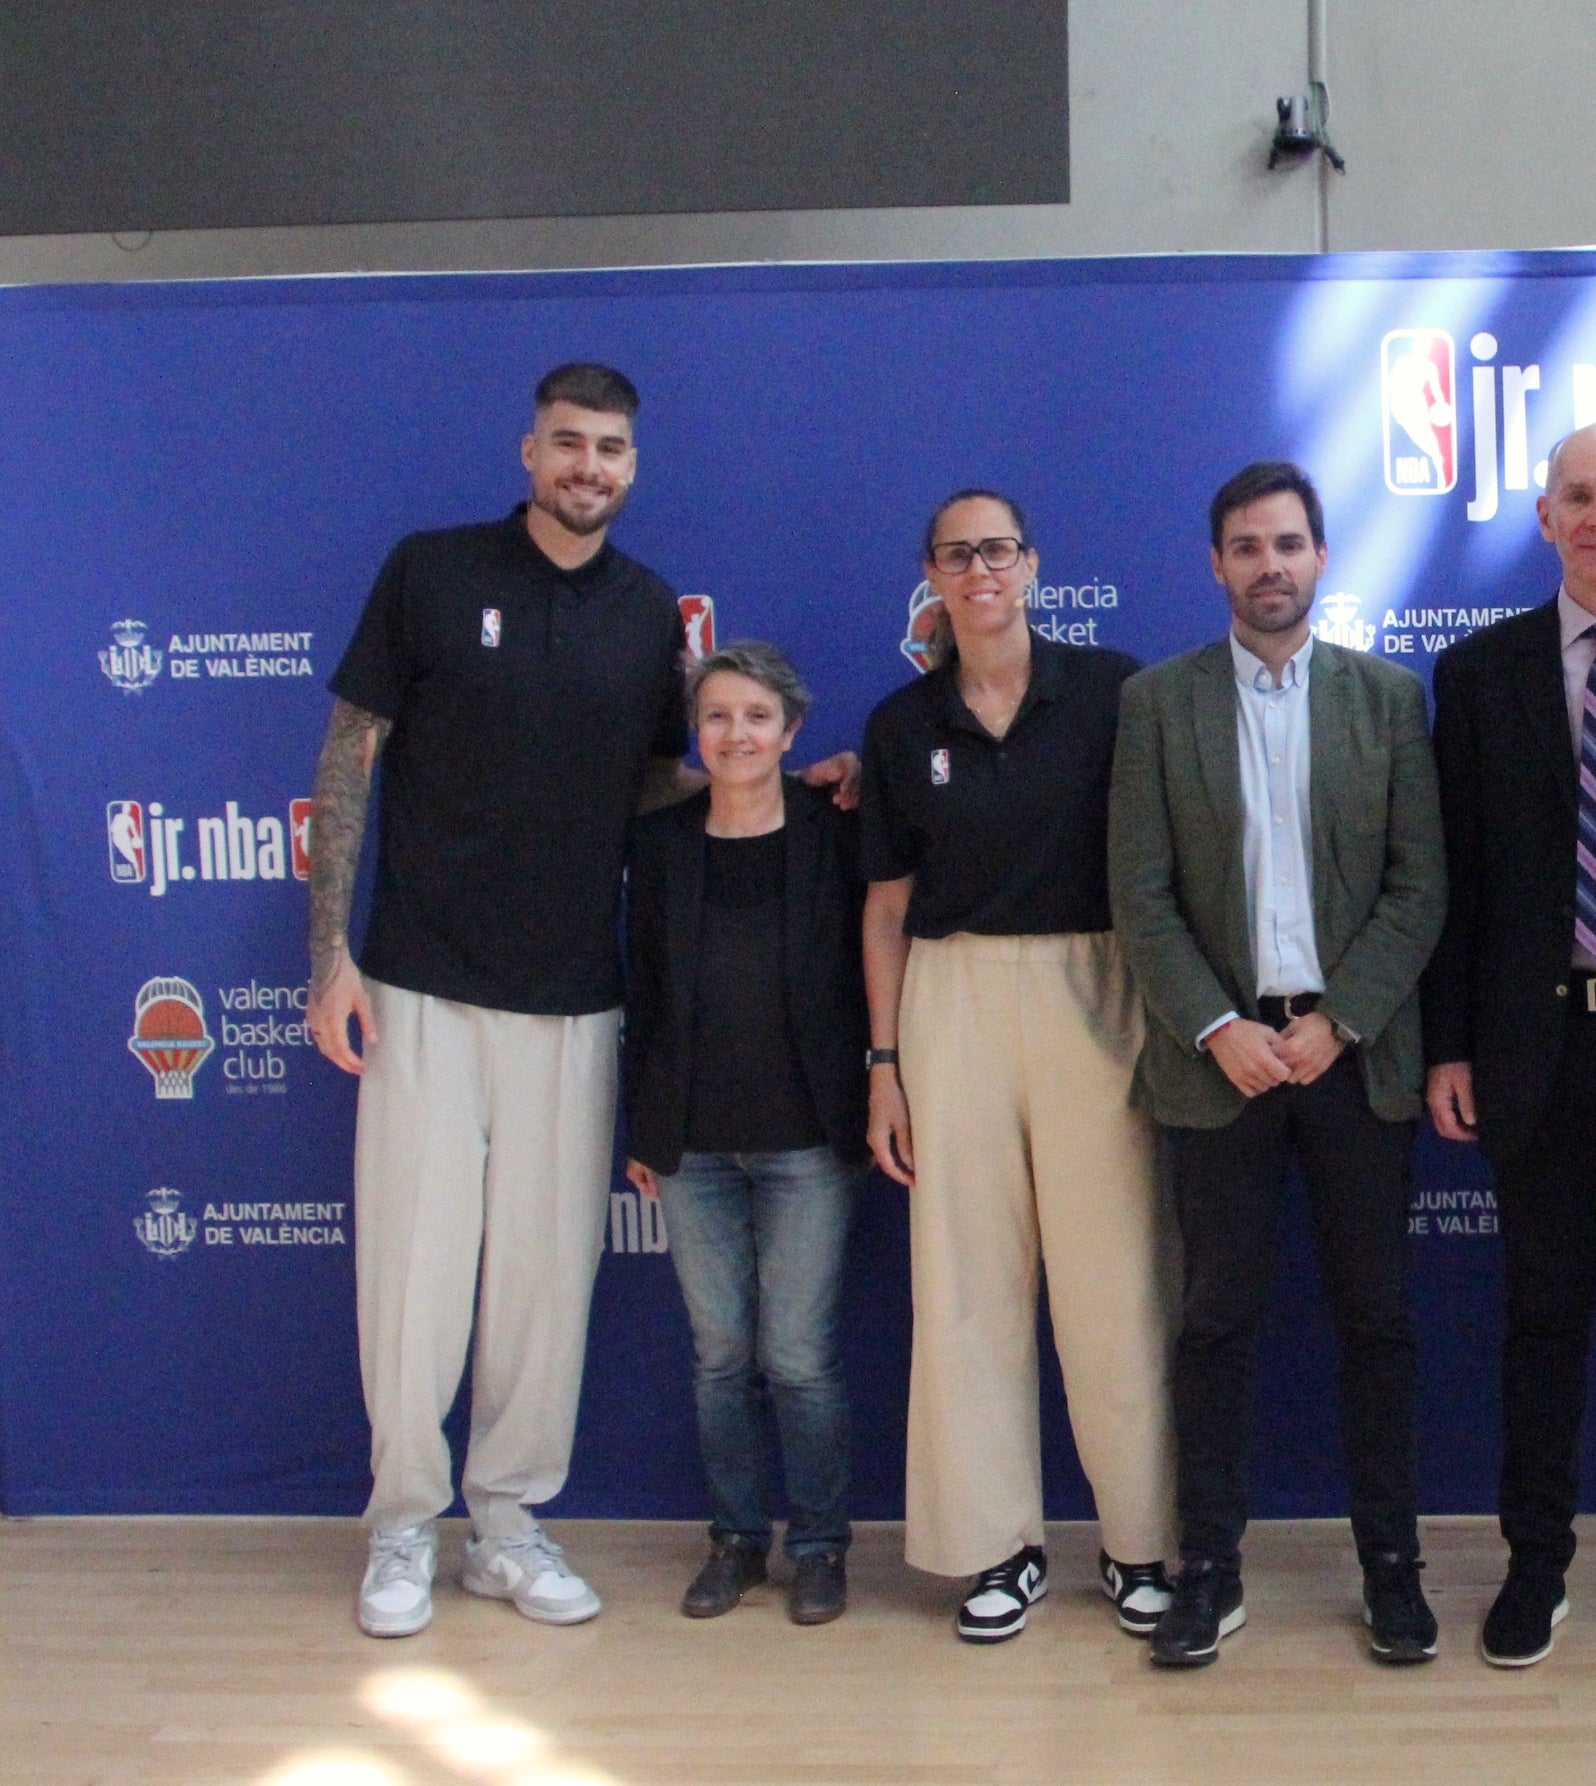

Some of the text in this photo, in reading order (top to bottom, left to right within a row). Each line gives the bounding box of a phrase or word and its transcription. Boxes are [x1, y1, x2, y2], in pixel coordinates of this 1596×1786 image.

[1396, 457, 1430, 484] NBA
[168, 632, 313, 653] AJUNTAMENT
[1384, 634, 1414, 653] DE
[170, 654, 313, 678] DE VALÈNCIA
[149, 801, 286, 896] jr.nba
[221, 1015, 314, 1045] basket
[223, 1050, 286, 1079] club
[203, 1203, 345, 1221] AJUNTAMENT
[205, 1223, 345, 1245] DE VALÈNCIA
